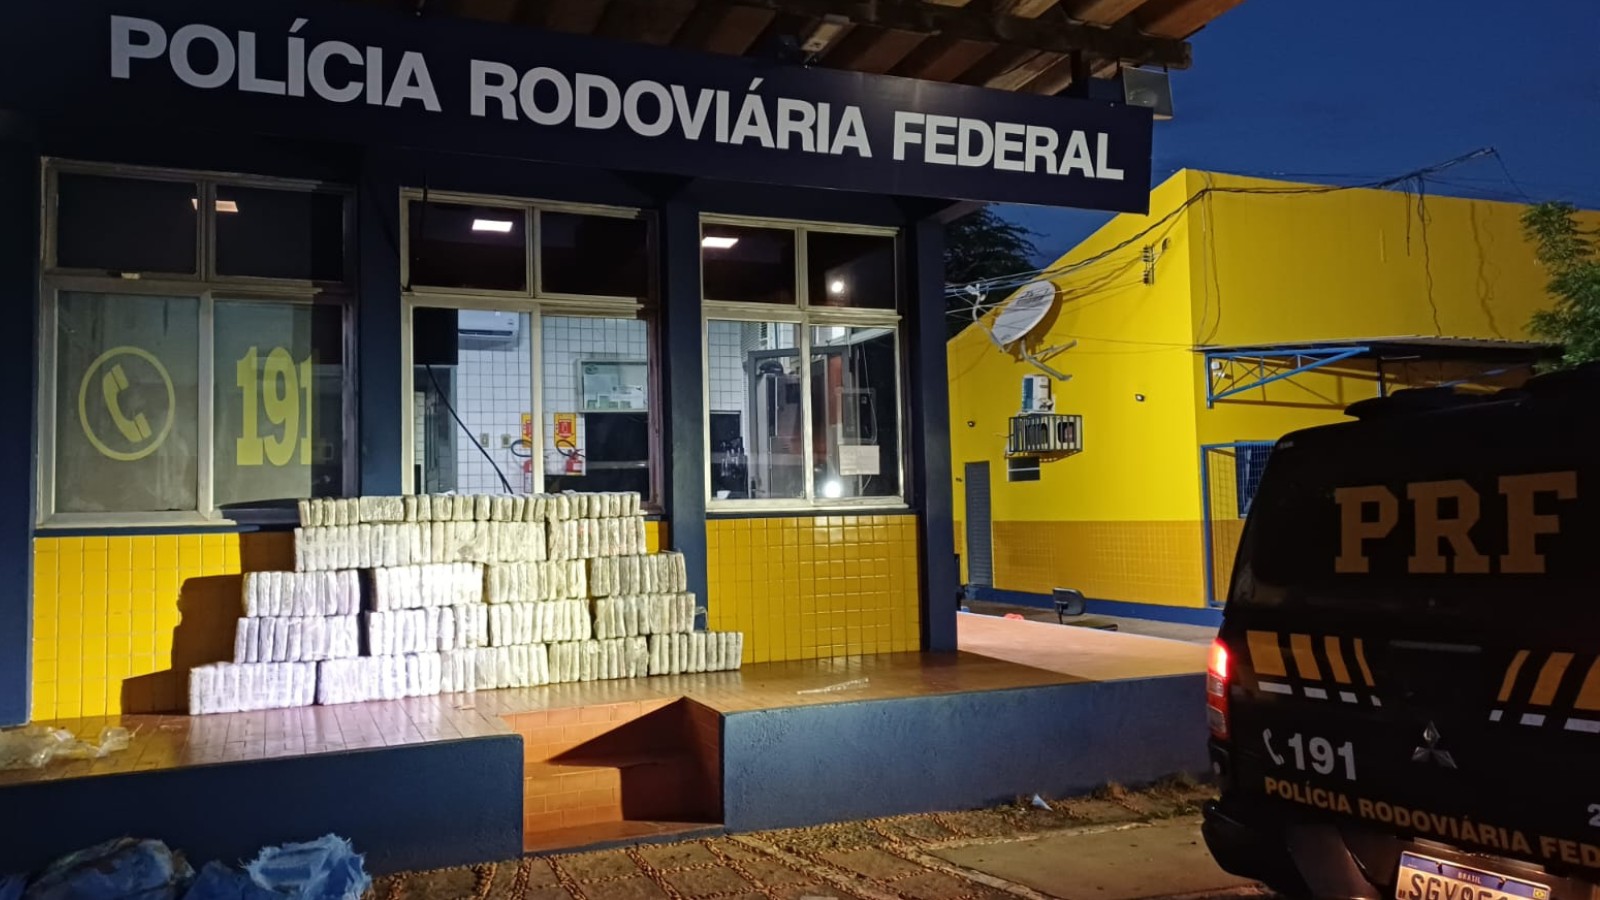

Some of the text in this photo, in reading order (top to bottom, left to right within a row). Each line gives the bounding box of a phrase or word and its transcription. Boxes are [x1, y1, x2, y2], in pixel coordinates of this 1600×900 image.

[111, 16, 1125, 182] POLÍCIA RODOVIÁRIA FEDERAL
[236, 345, 321, 466] 191
[1334, 471, 1577, 573] PRF
[1288, 733, 1356, 781] 191
[1264, 776, 1352, 814] POLÍCIA
[1358, 798, 1532, 854] RODOVIÁRIA
[1457, 871, 1481, 884] BRASIL
